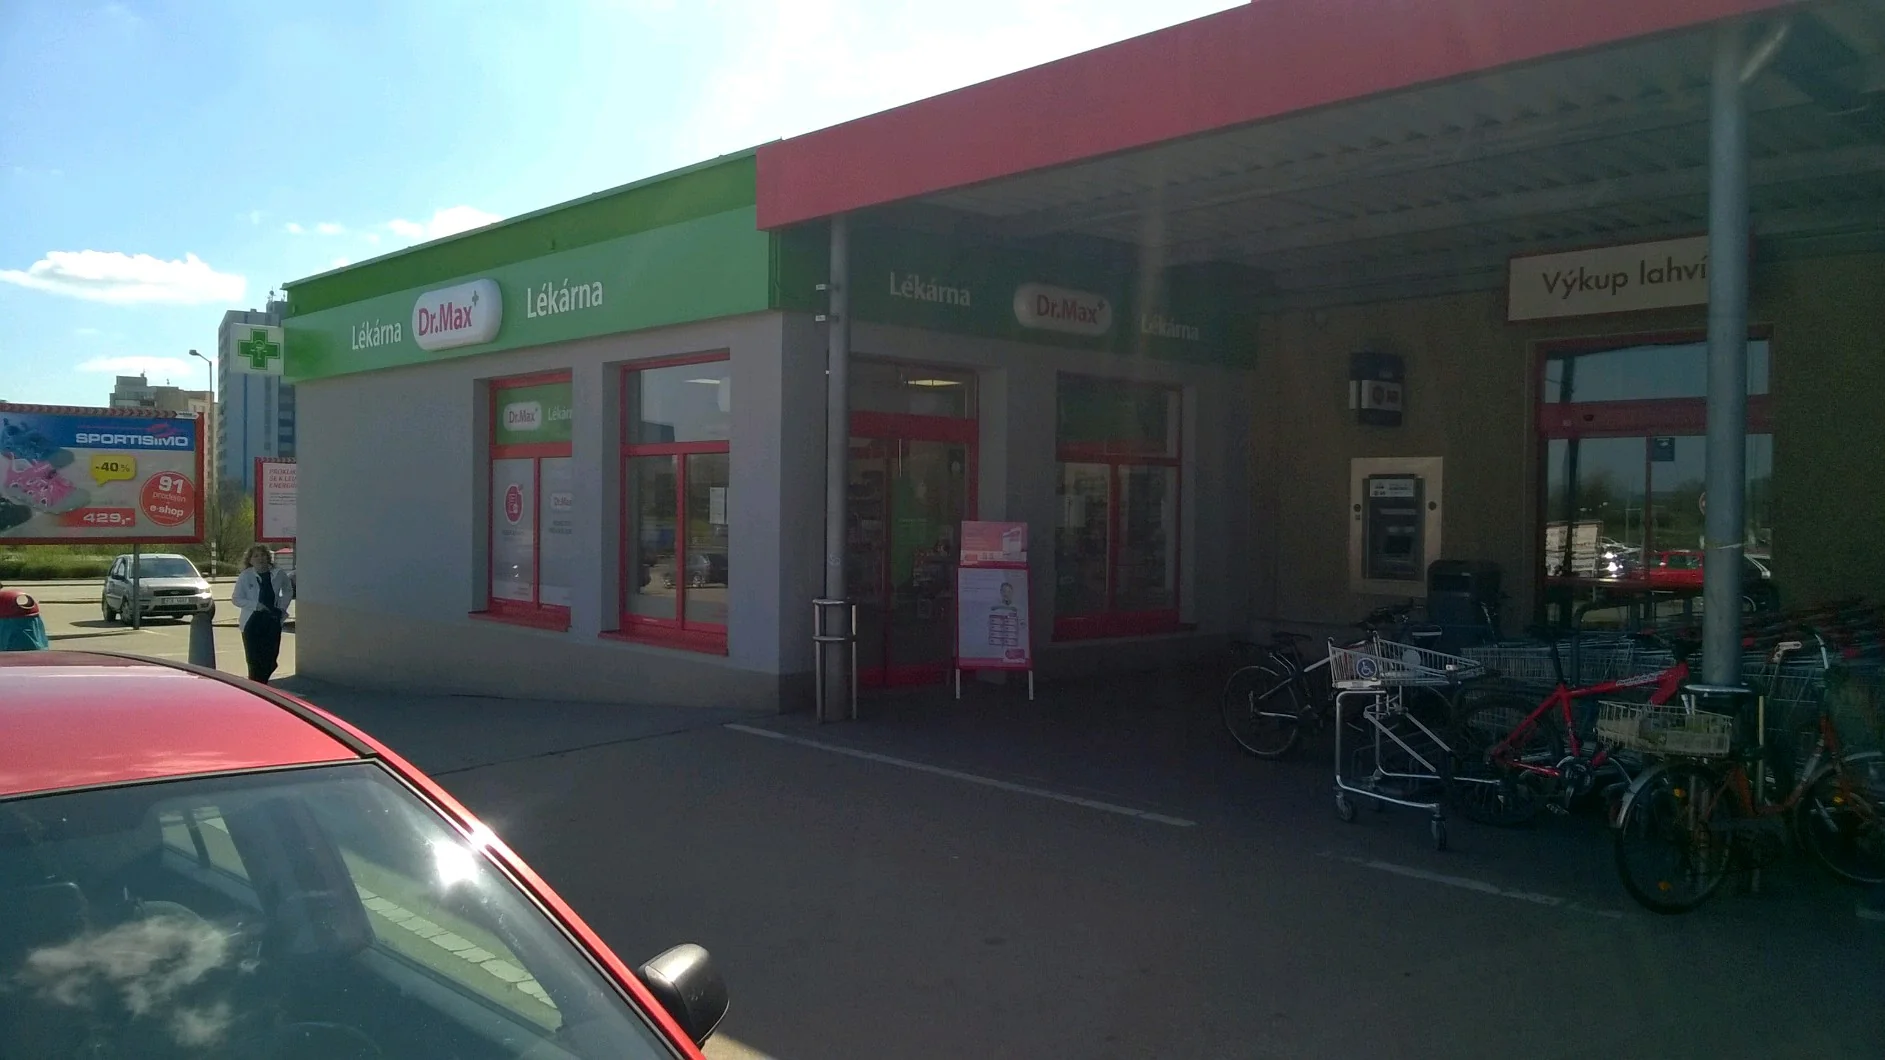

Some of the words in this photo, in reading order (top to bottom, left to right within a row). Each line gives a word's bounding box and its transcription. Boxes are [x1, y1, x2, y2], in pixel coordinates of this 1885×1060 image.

[527, 277, 604, 319] Lékárna
[890, 271, 971, 307] Lékárna
[1542, 266, 1629, 300] Výkup
[418, 302, 473, 337] Dr.Max
[1036, 294, 1098, 326] Dr.Max
[1142, 313, 1199, 341] Lékárna
[352, 317, 402, 351] Lékárna
[508, 410, 536, 425] Dr.Max
[158, 475, 184, 494] 91
